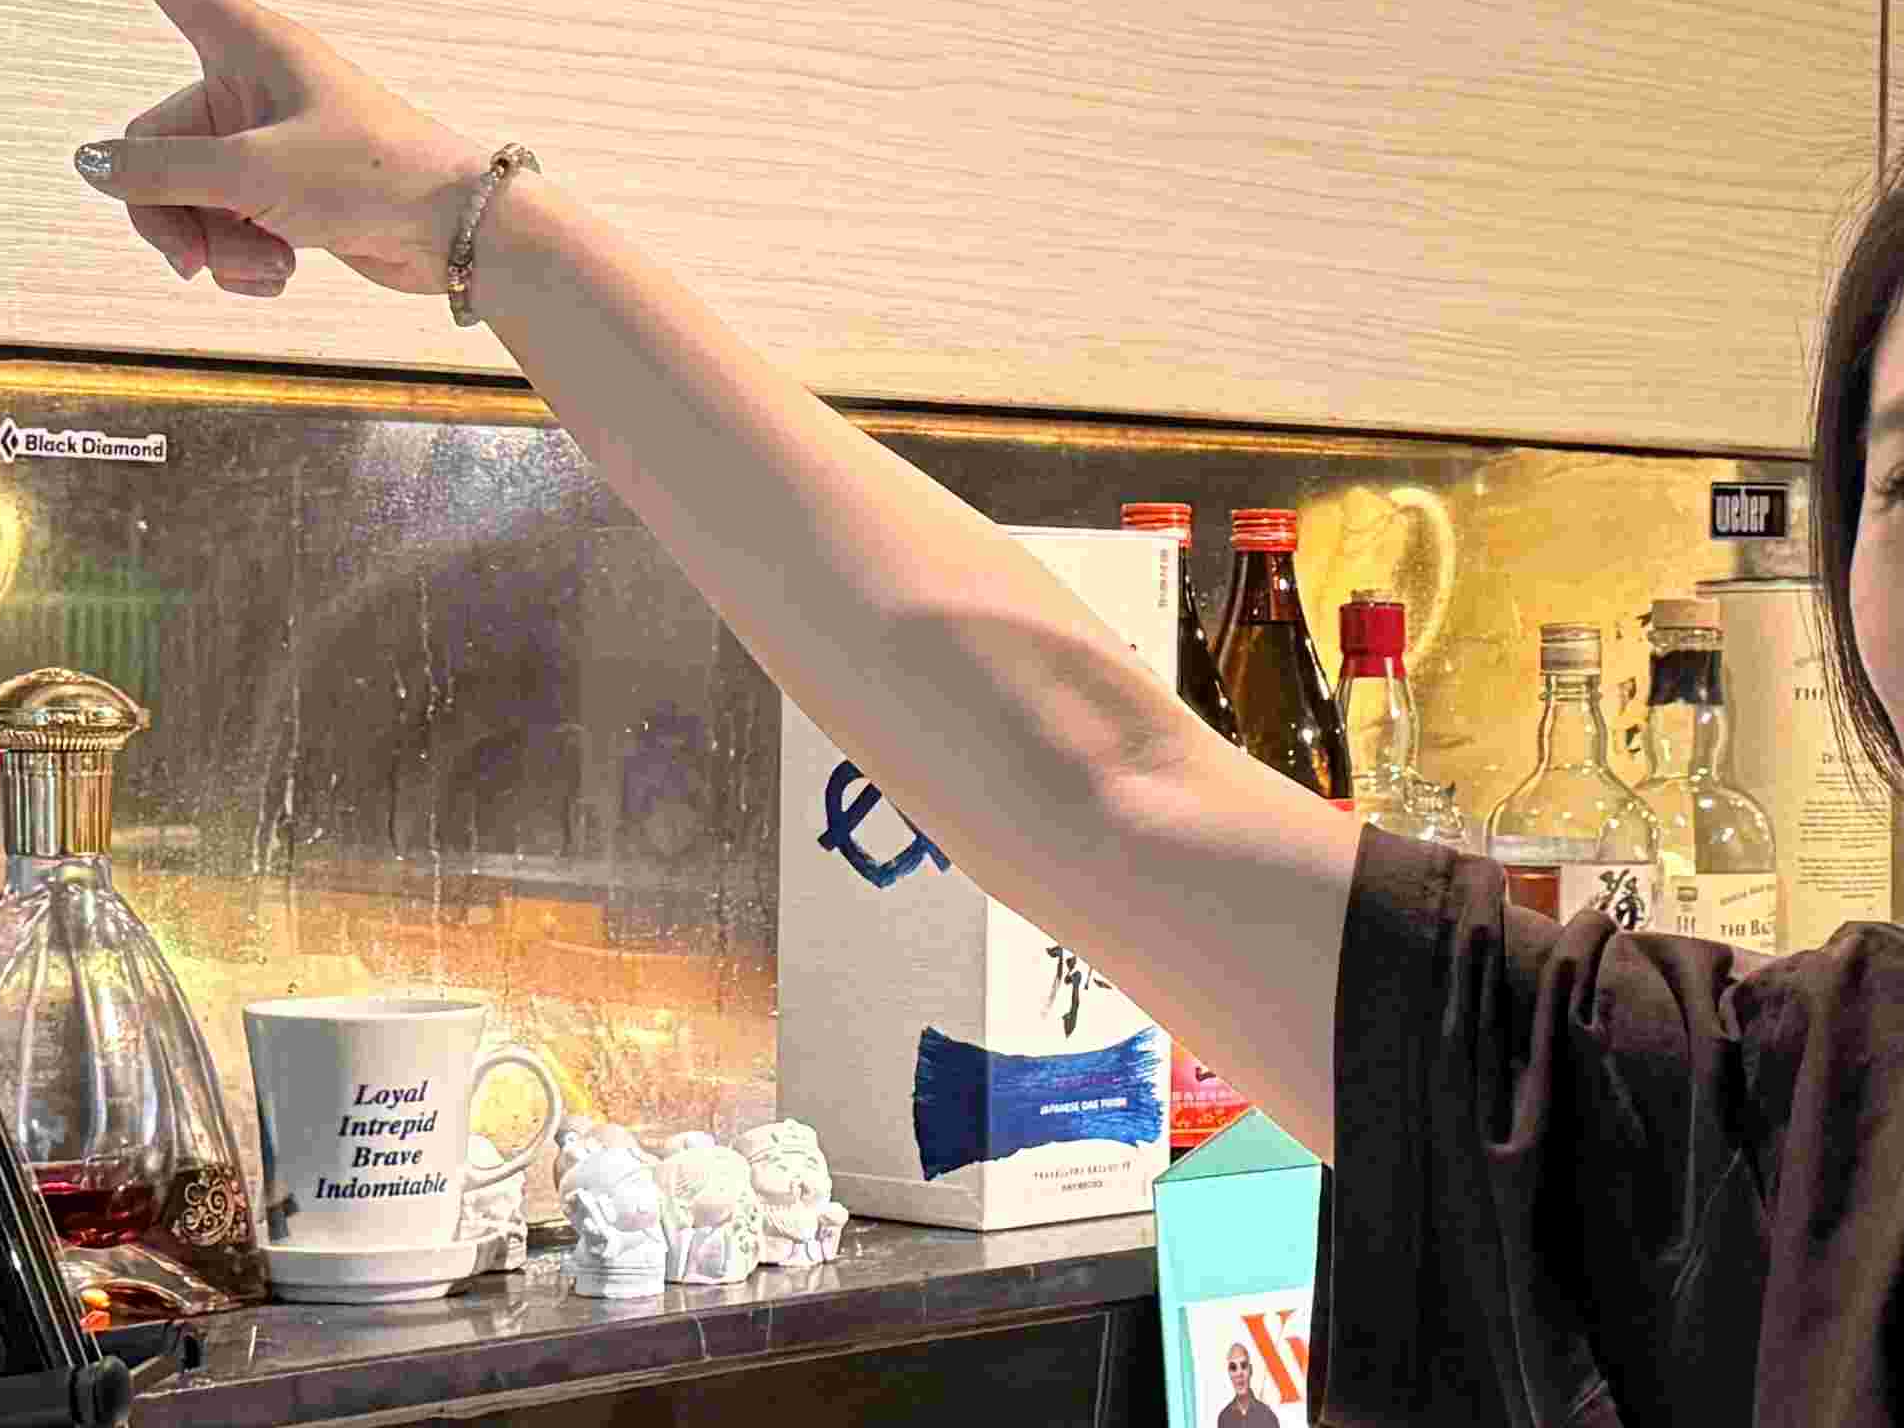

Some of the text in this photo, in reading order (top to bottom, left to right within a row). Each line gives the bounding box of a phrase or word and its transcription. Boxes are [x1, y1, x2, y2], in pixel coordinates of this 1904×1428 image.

[24, 434, 164, 458] Black Diamond
[354, 1079, 428, 1109] Loyal
[337, 1110, 438, 1140] Intrepid
[352, 1146, 423, 1167] Brave
[315, 1172, 448, 1199] Indomitable
